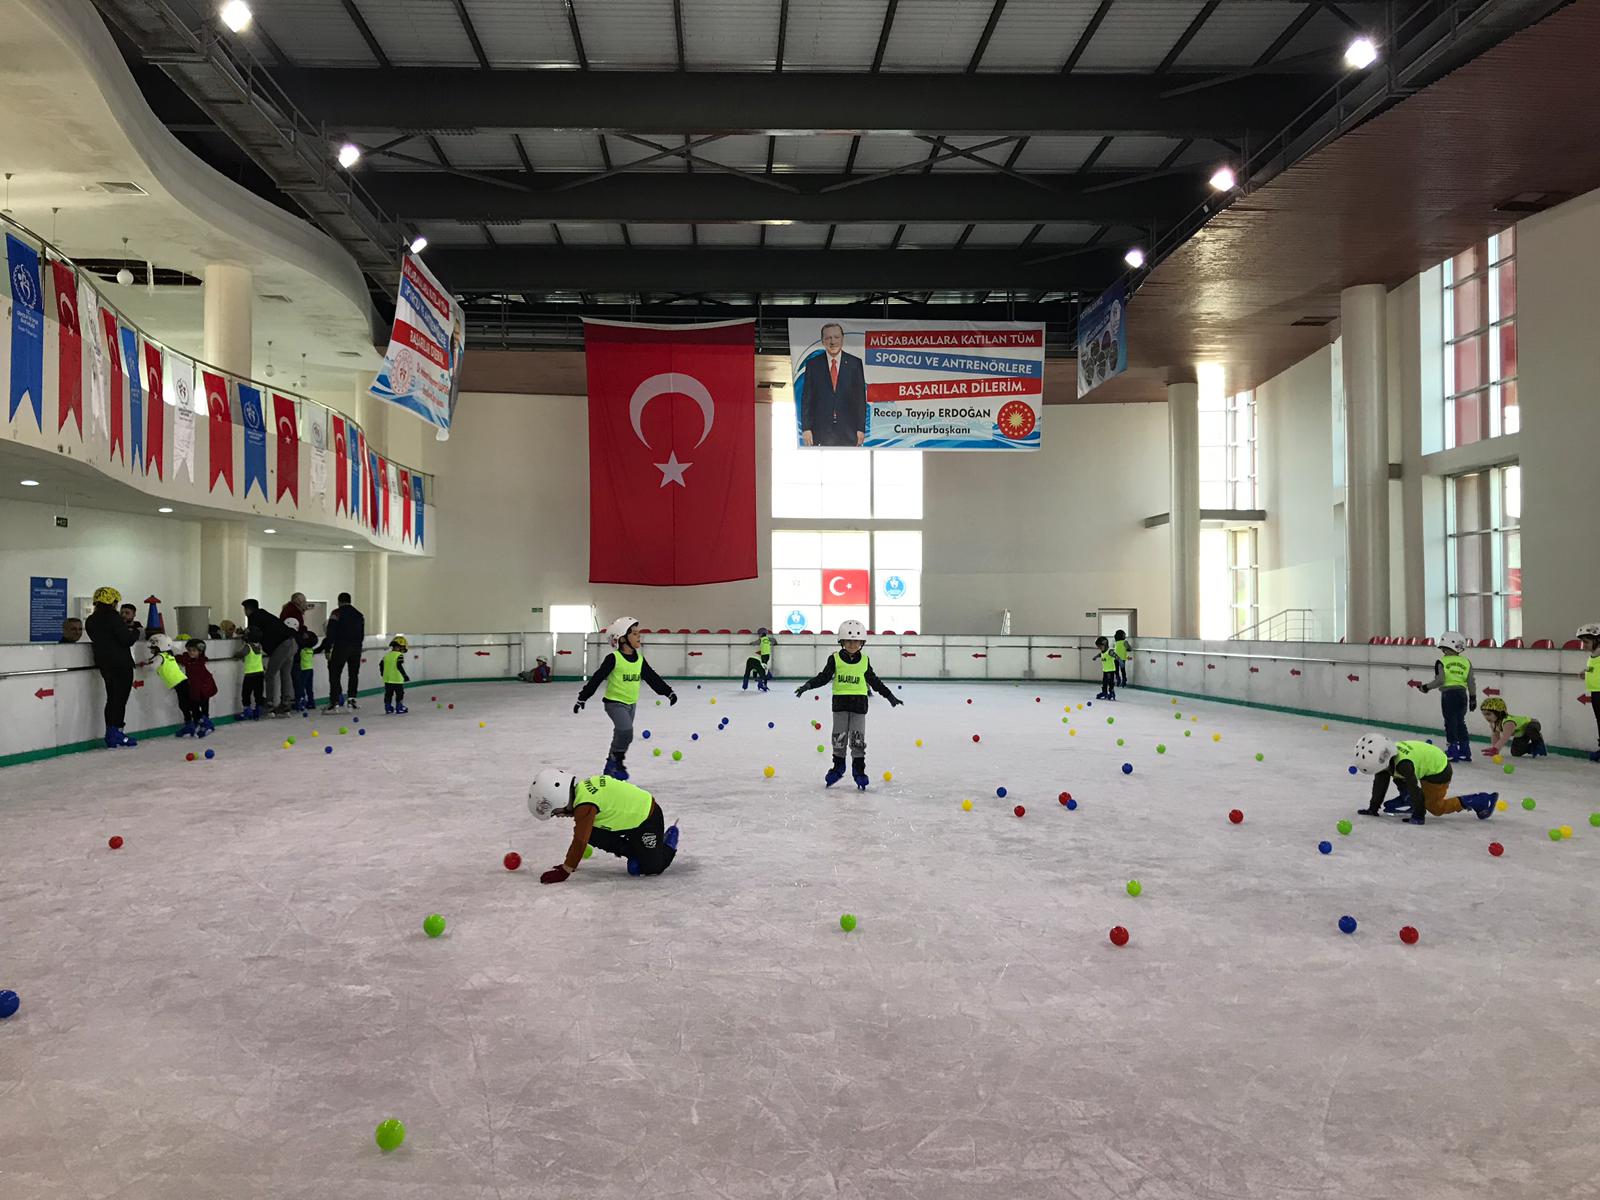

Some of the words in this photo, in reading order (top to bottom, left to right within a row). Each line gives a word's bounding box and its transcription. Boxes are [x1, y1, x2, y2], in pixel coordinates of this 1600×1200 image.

[870, 334, 958, 346] MÜSABAKALARA
[961, 335, 1007, 345] KATILAN
[1010, 332, 1035, 344] TÜM
[875, 352, 921, 366] SPORCU
[925, 356, 939, 367] VE
[941, 358, 1033, 374] ANTRENÖRLERE
[899, 382, 967, 398] BAŞARILAR
[971, 378, 1026, 393] DİLERİM.
[873, 407, 902, 419] Recep
[905, 408, 936, 420] Tayyip
[938, 406, 991, 418] ERDOĞAN
[894, 424, 971, 436] Cumhurbaşkanı
